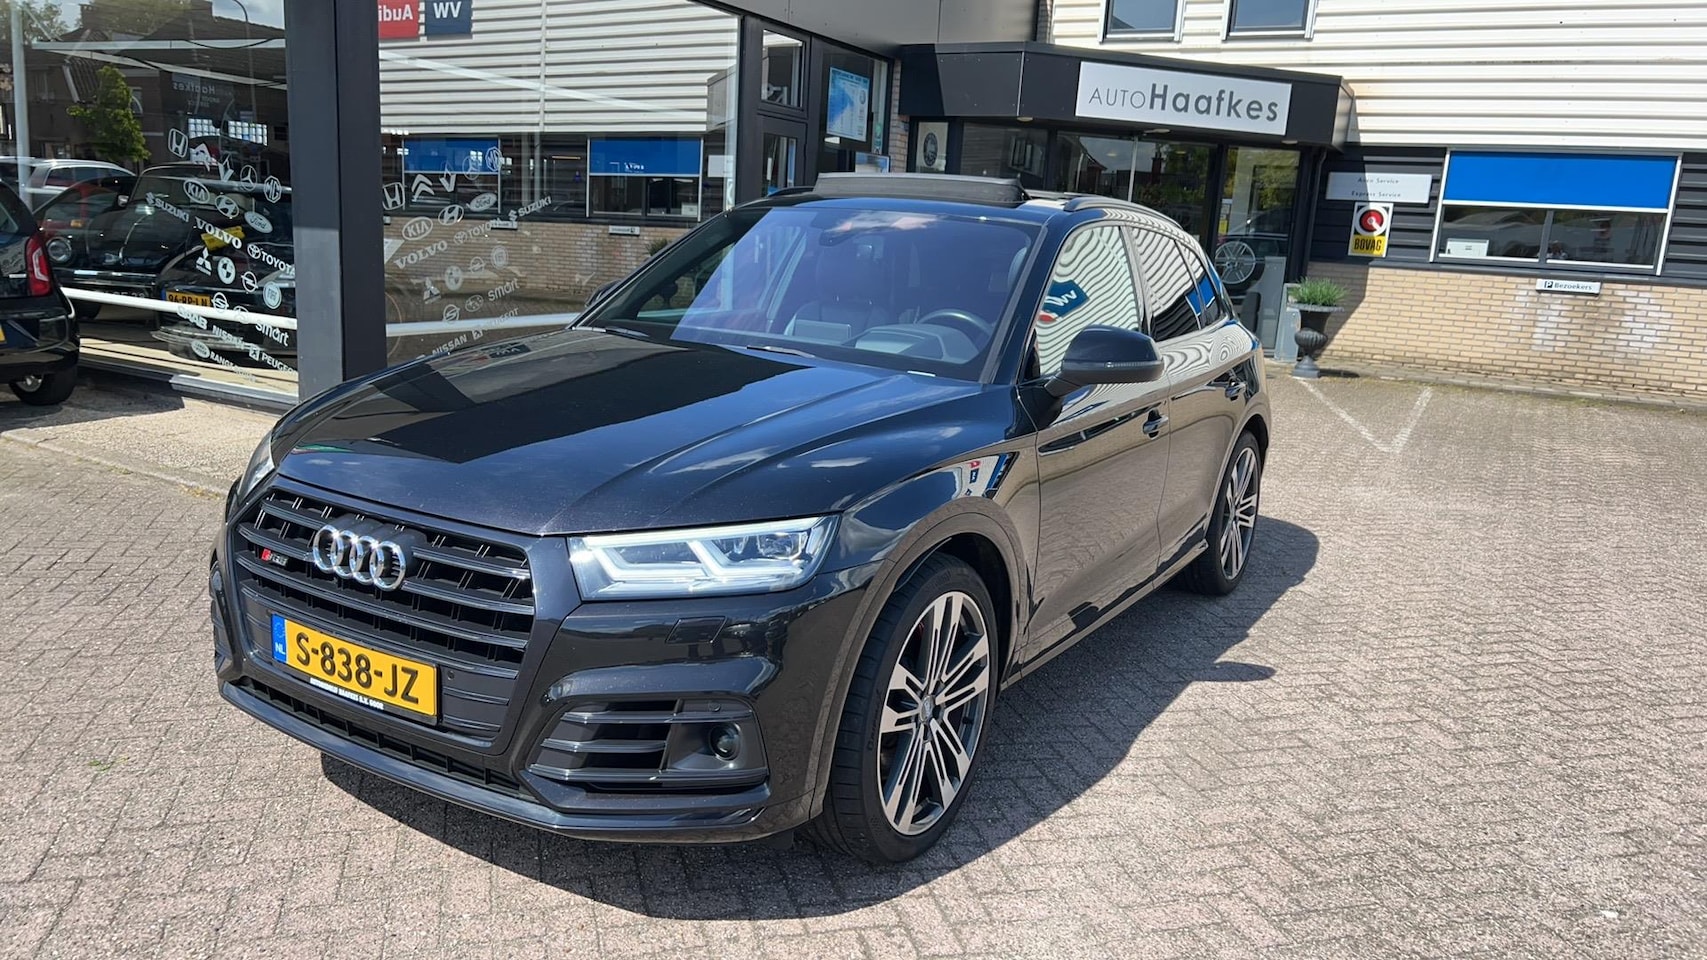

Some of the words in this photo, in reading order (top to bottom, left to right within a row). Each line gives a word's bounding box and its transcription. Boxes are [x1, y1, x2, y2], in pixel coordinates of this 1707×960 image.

[187, 182, 206, 201] KIA
[154, 198, 190, 222] SUZUKI
[518, 196, 552, 217] SUZUKI
[194, 216, 242, 249] VOLVO
[407, 221, 430, 237] KIA
[394, 240, 448, 270] VOLVO
[1354, 239, 1382, 251] BOVAG
[487, 277, 520, 302] smart
[1554, 282, 1592, 291] Bezoekers
[255, 319, 289, 347] smart
[274, 642, 286, 655] NL
[296, 632, 419, 704] S-838-JZ
